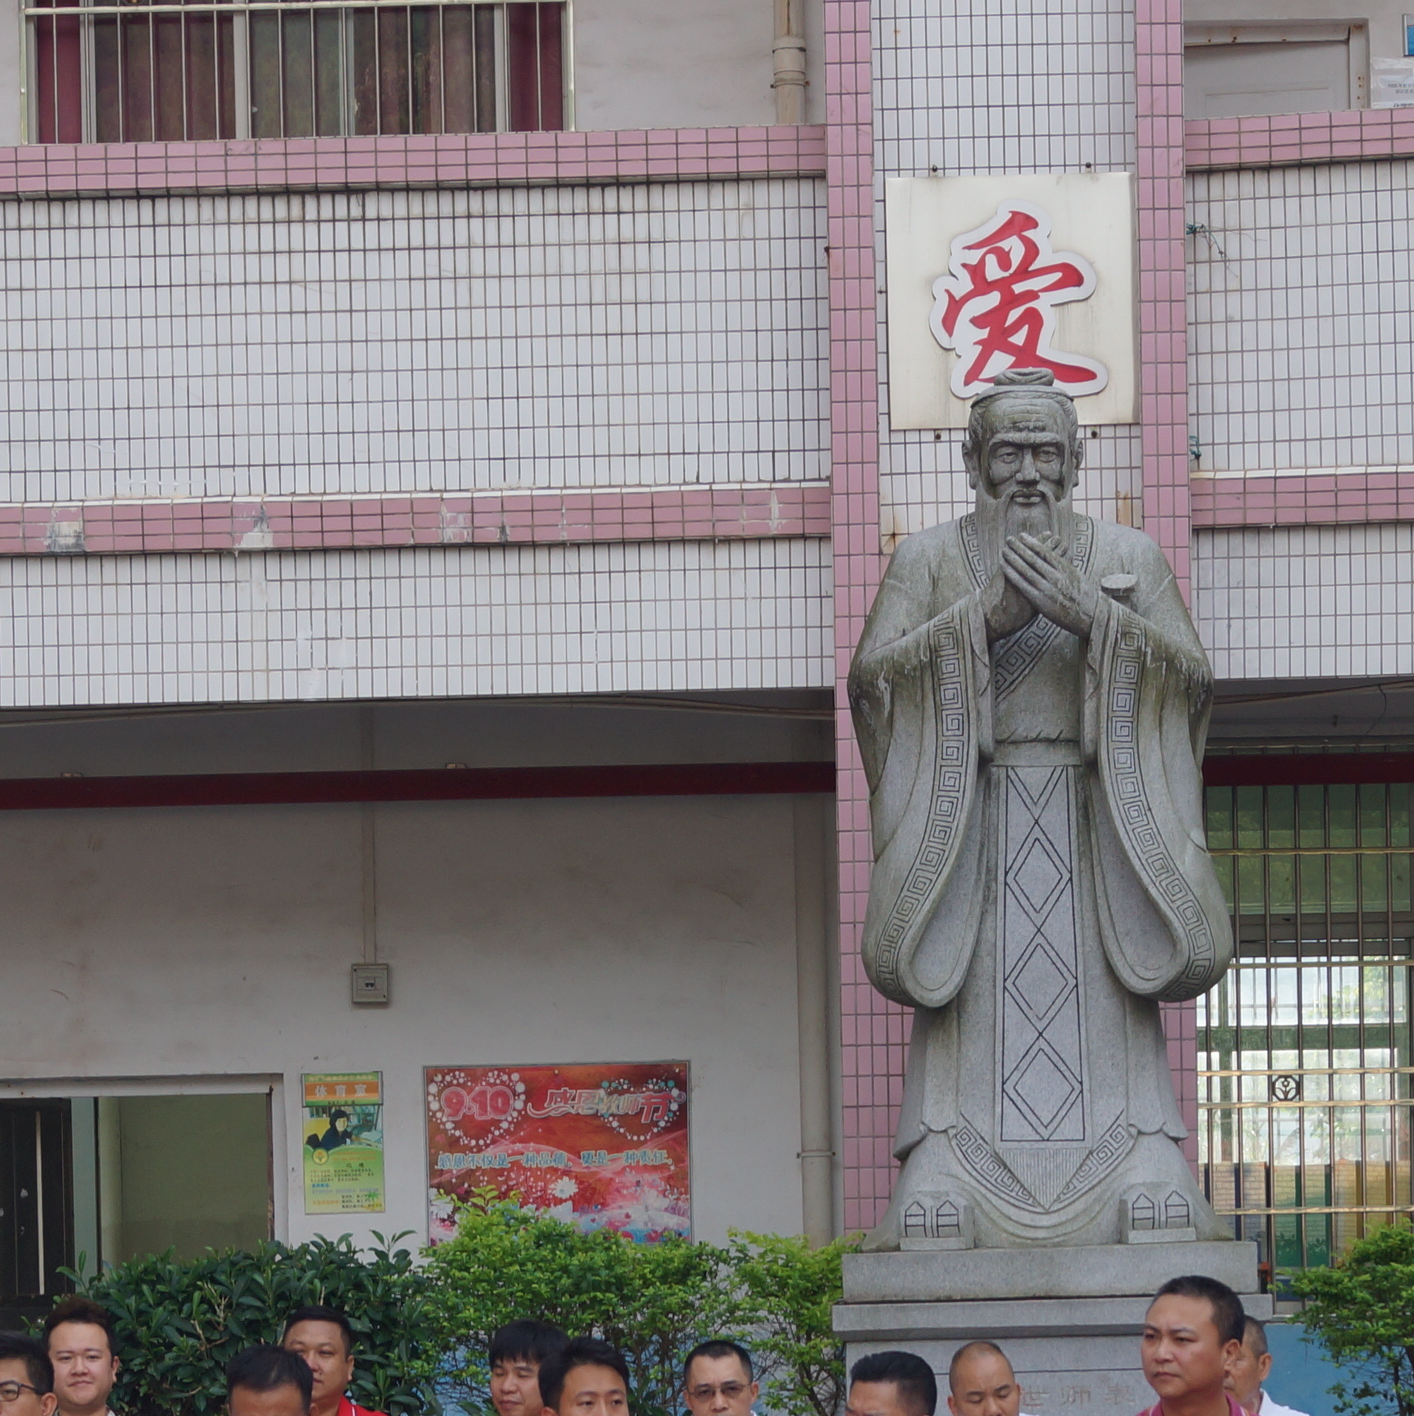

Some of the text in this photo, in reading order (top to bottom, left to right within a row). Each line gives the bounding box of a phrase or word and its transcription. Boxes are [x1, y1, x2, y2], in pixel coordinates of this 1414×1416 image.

[941, 210, 1098, 387] 爱
[529, 1087, 684, 1124] 感恩教师节
